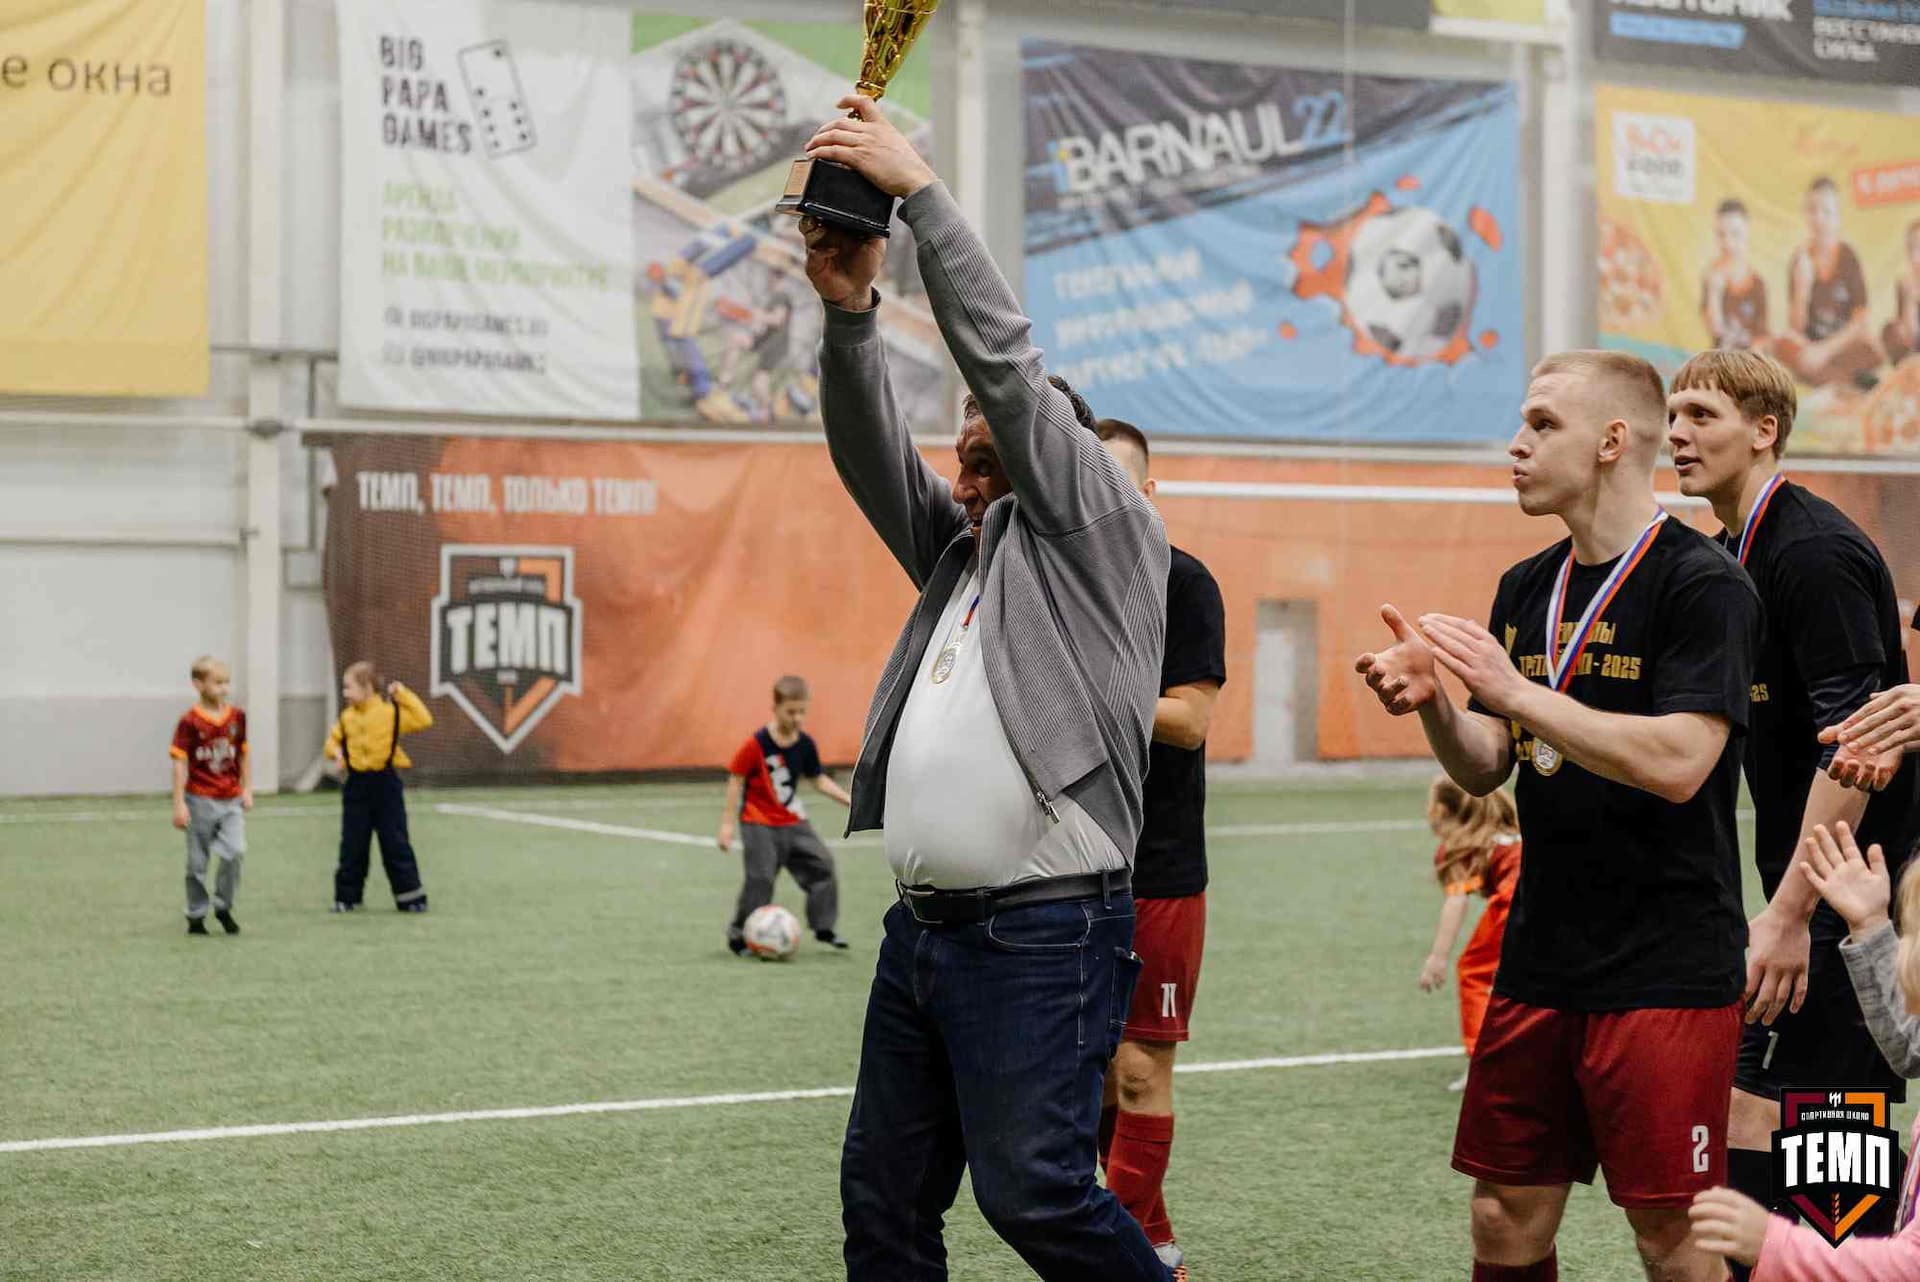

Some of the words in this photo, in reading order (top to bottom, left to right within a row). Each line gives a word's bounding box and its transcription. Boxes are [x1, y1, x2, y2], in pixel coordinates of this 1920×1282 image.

[380, 35, 423, 71] BIG
[48, 57, 172, 97] окна
[382, 75, 449, 112] PAPA
[382, 112, 472, 155] GAMES
[446, 601, 568, 676] ТЕМП
[1160, 982, 1178, 1019] 11
[1691, 1124, 1710, 1174] 2
